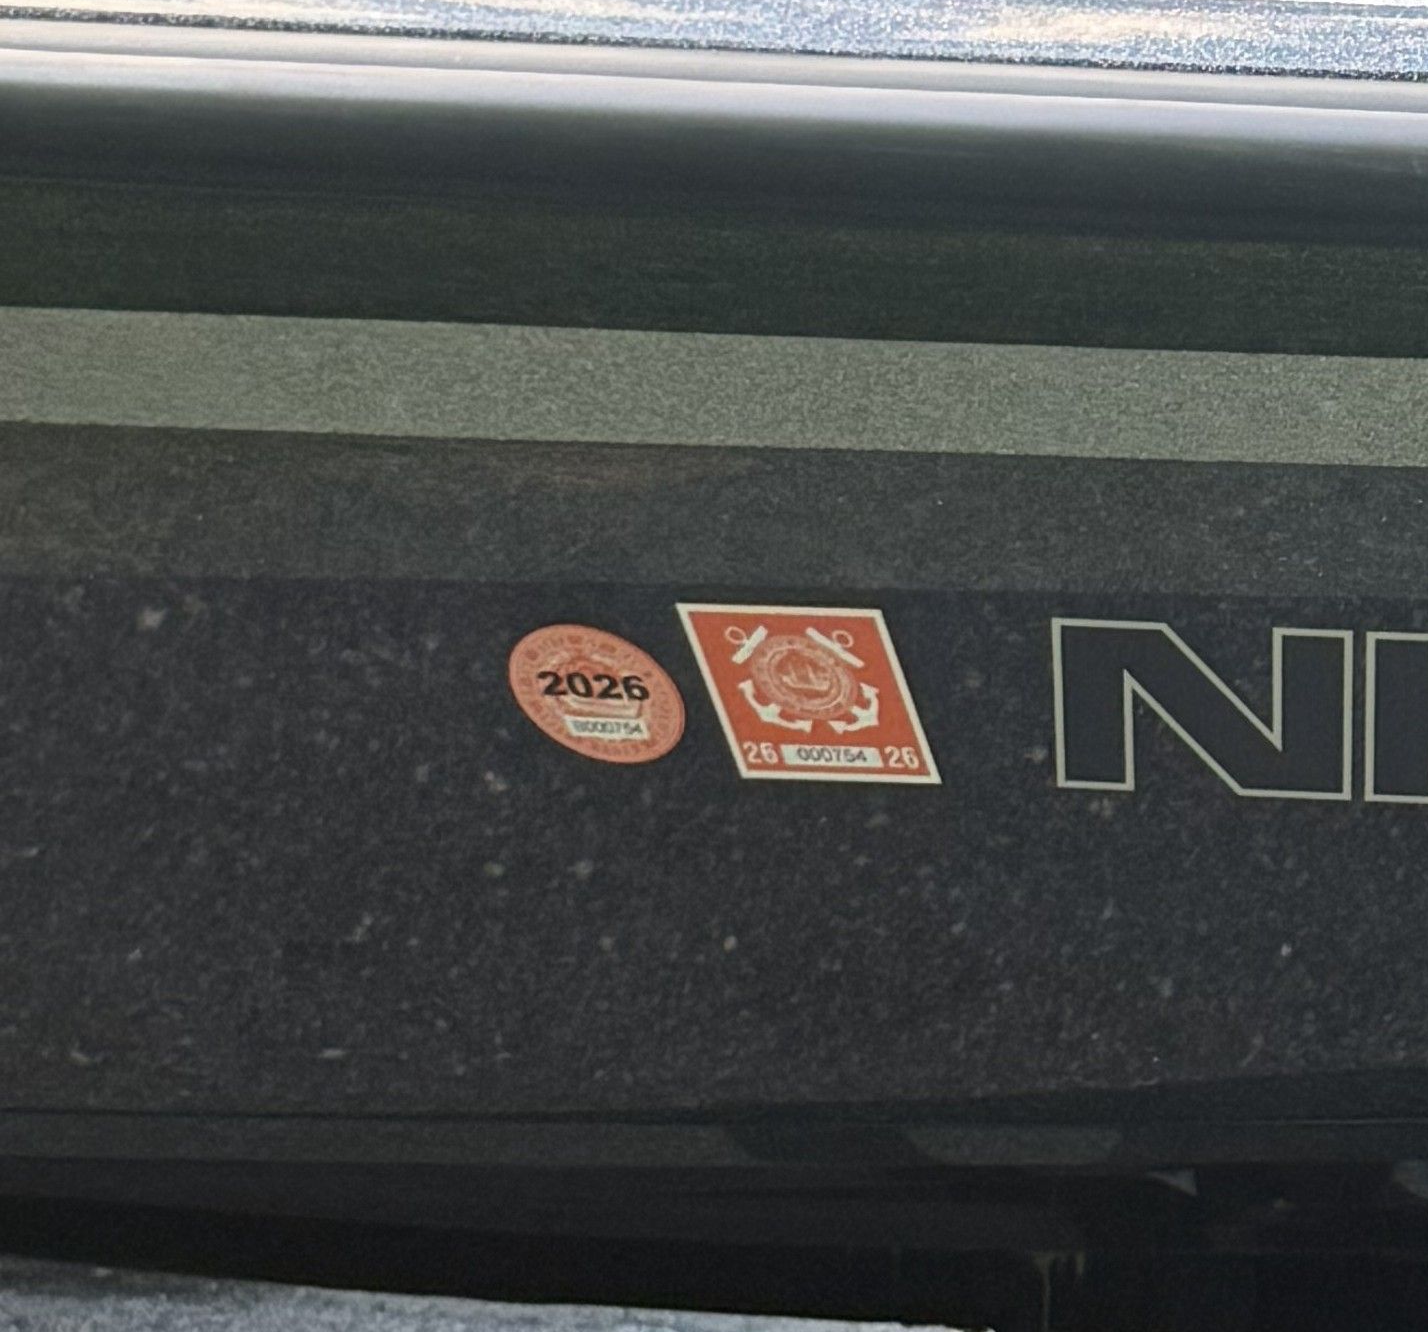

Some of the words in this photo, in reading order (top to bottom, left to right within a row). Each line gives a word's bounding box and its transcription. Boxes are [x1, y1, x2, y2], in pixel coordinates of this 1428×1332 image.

[537, 671, 650, 701] 2026
[743, 741, 779, 764] 26
[796, 746, 868, 763] 000754
[883, 745, 919, 769] 26
